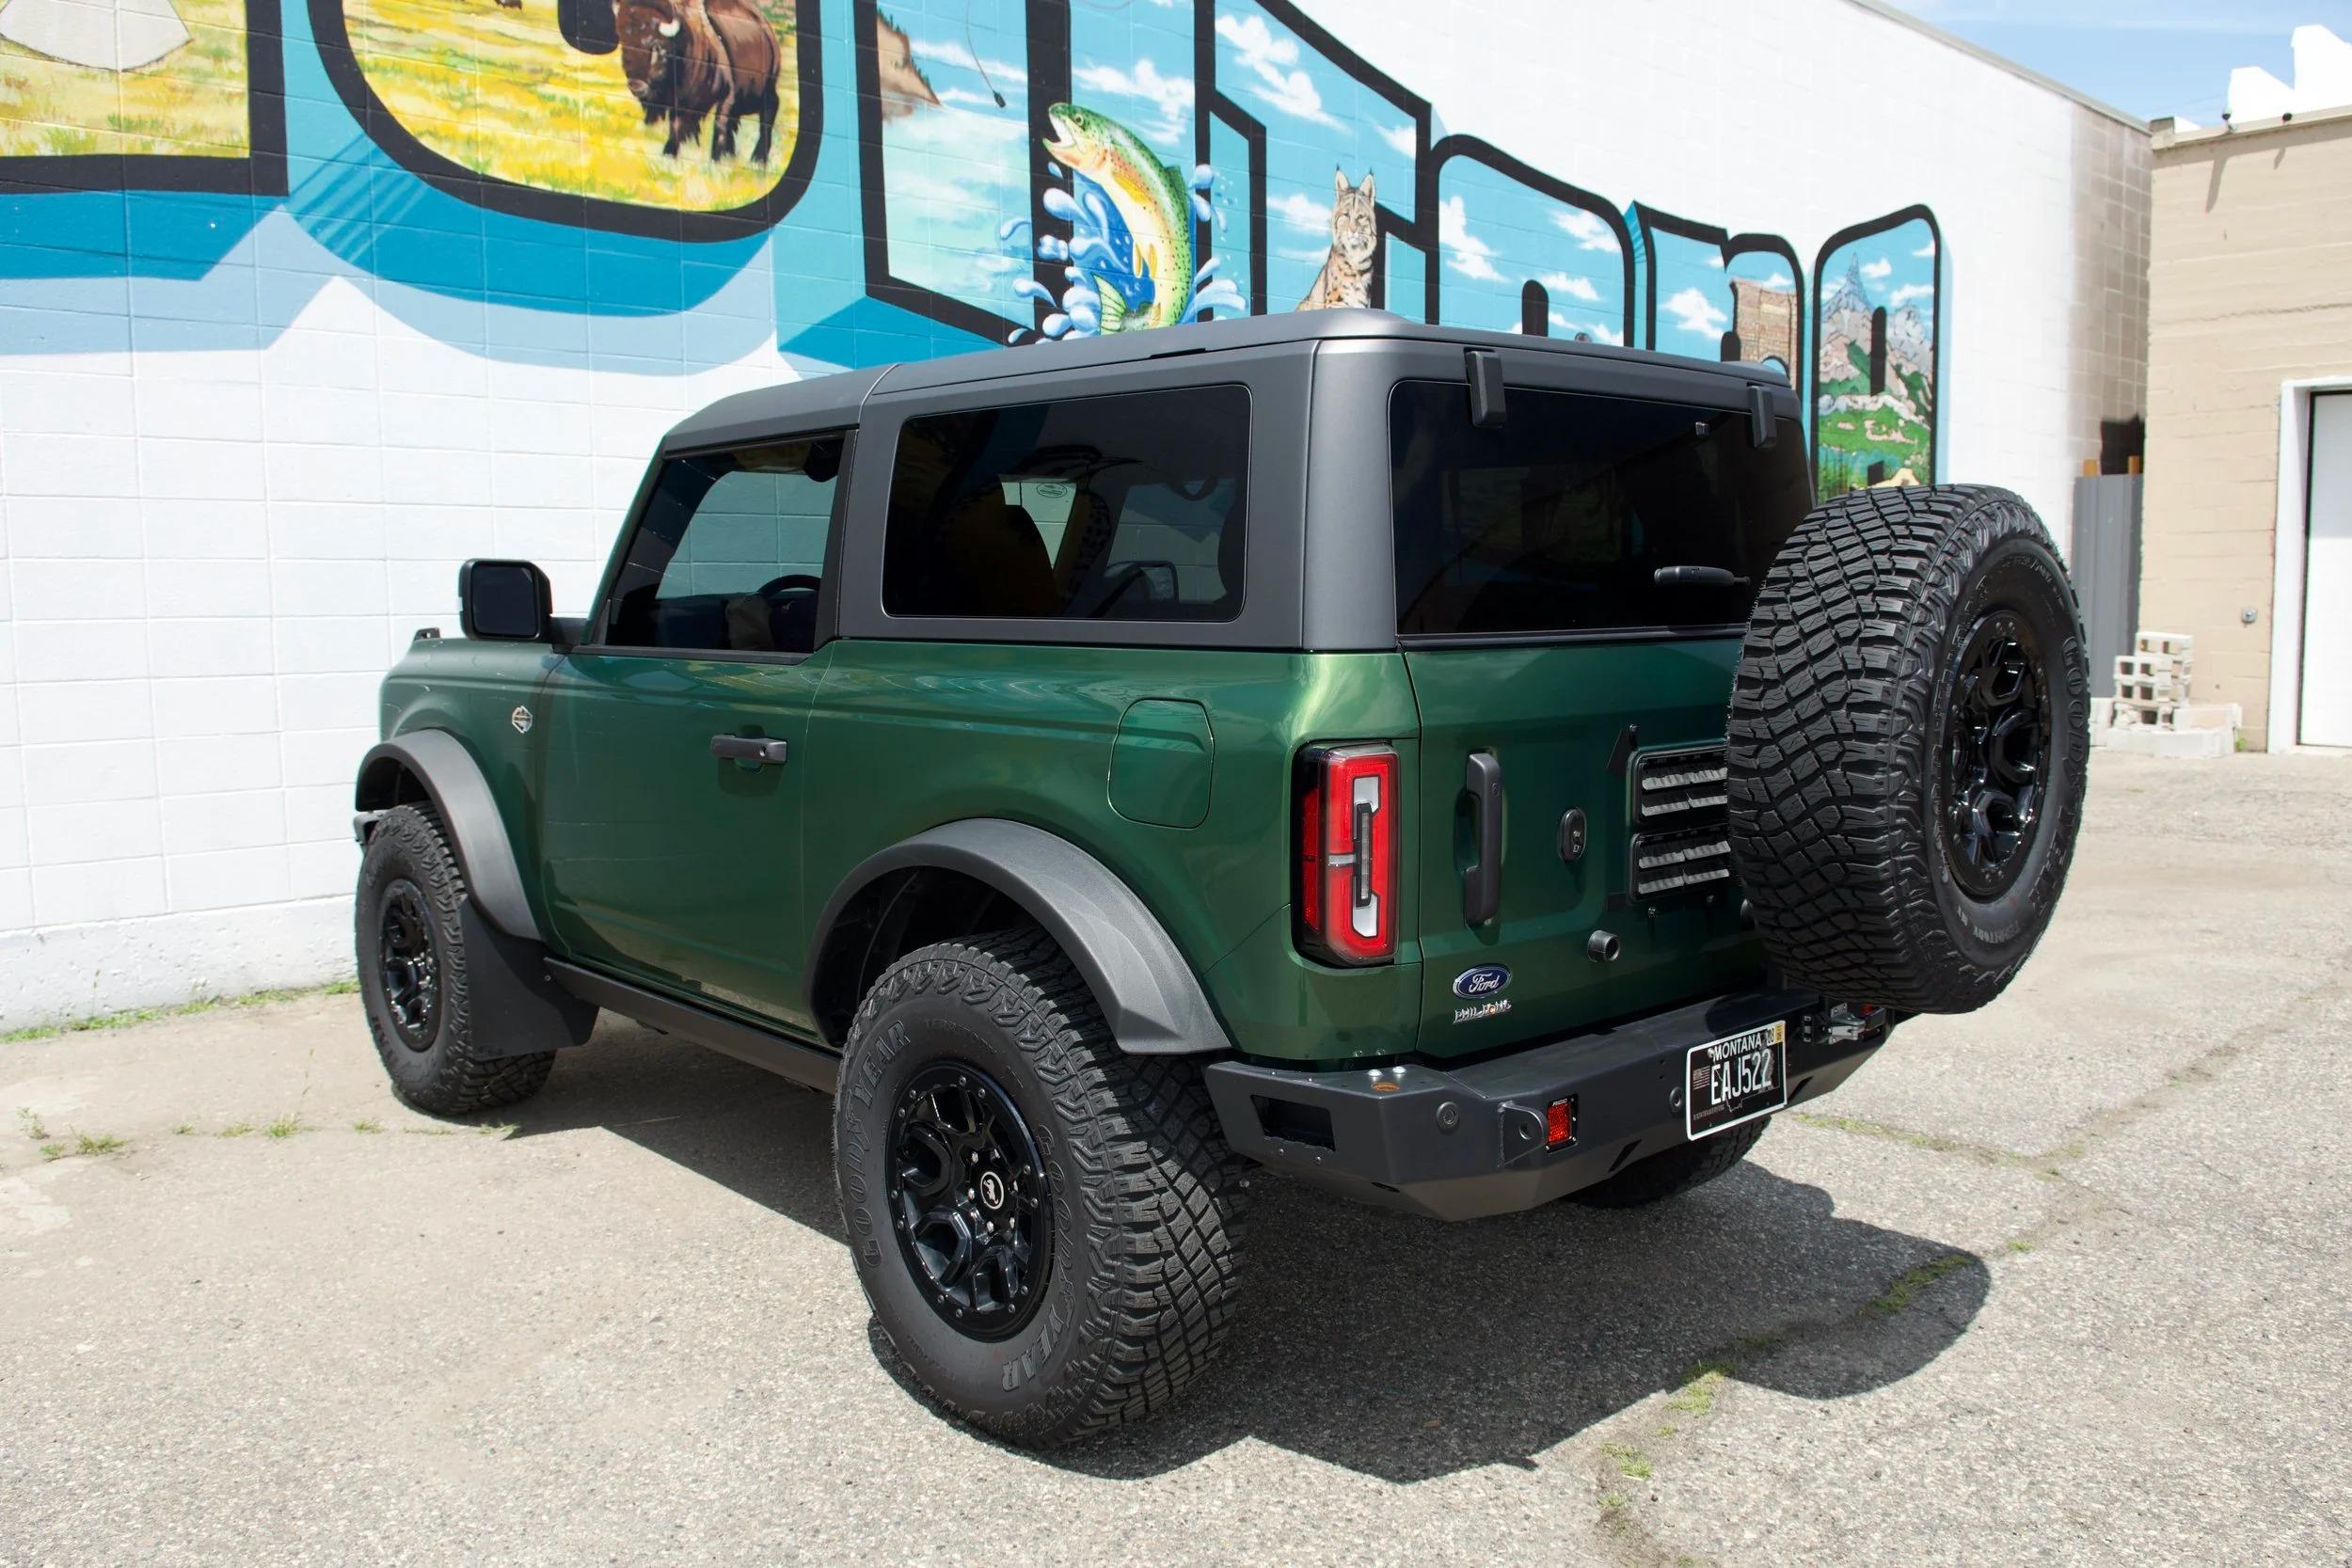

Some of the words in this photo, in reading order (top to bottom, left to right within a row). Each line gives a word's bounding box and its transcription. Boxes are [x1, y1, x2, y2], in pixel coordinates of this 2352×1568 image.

[1469, 973, 1501, 993] Ford
[1713, 1033, 1762, 1061] MONTANA
[1710, 1048, 1772, 1105] EAJ522
[846, 1020, 911, 1269] GOODYEAR
